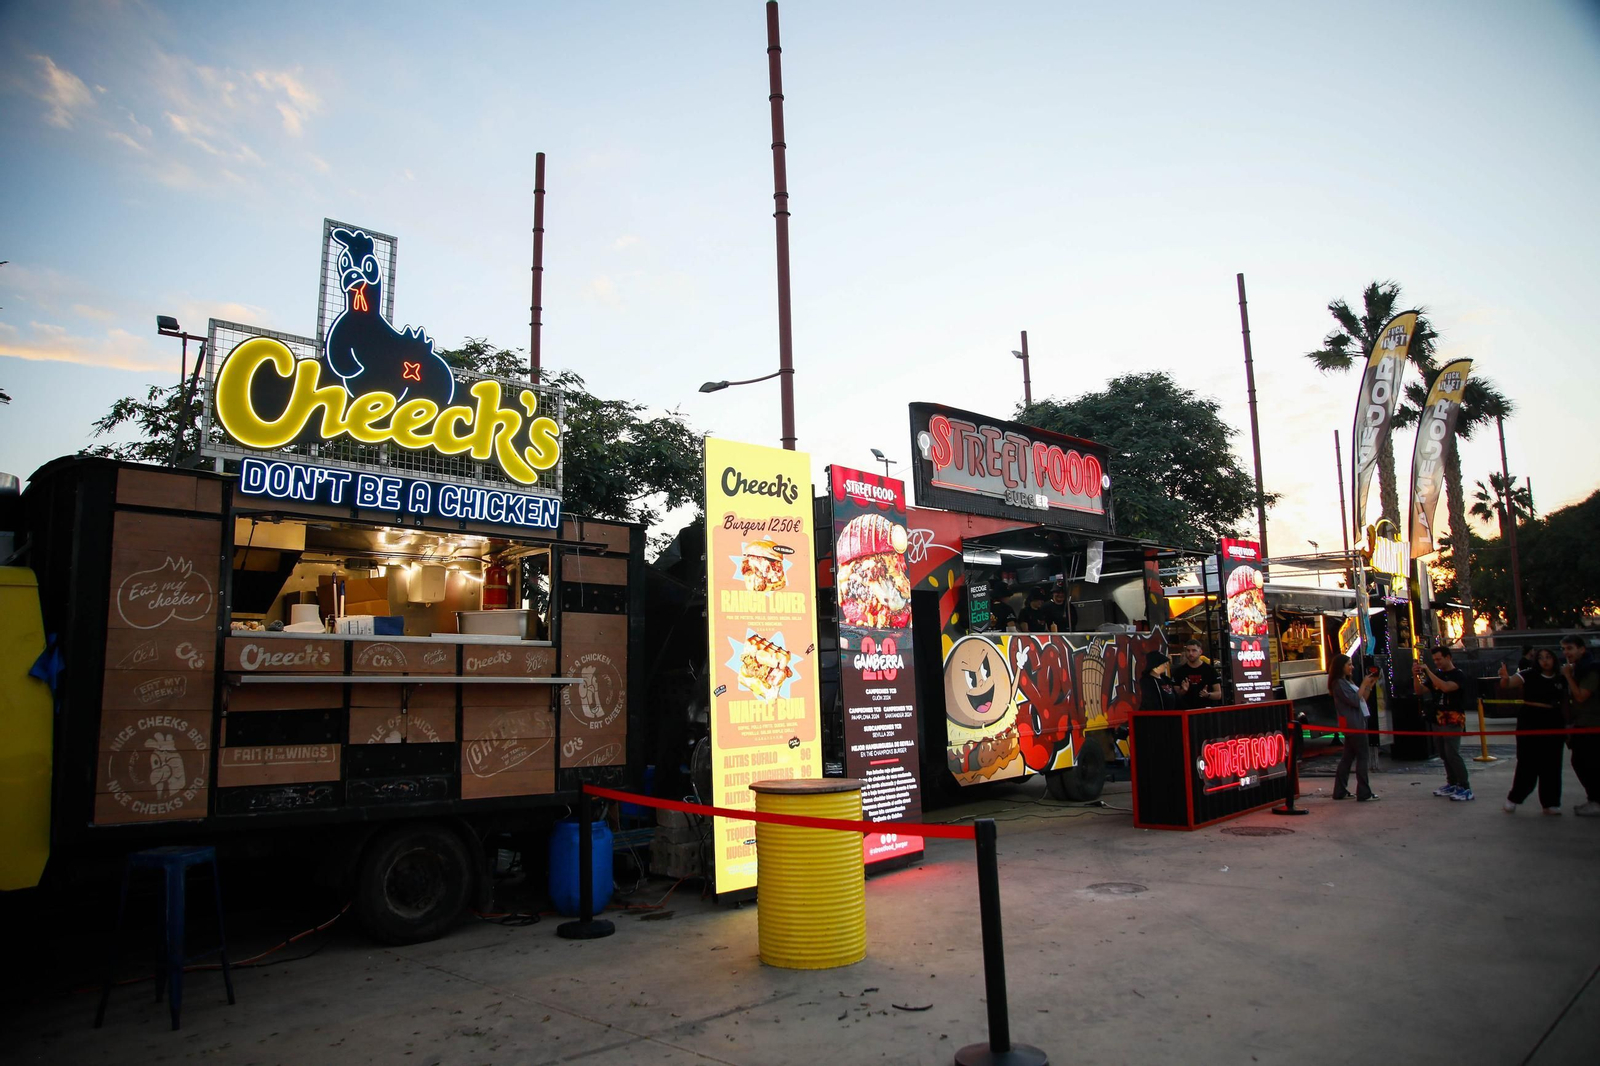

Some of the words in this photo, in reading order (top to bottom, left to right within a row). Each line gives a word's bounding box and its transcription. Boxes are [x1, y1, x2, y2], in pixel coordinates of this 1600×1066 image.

[1387, 325, 1404, 336] FUCK
[215, 336, 561, 485] Cheeck's
[930, 415, 1030, 489] STREET
[1032, 441, 1102, 498] FOOD
[1417, 400, 1451, 507] MEJOR
[240, 458, 352, 504] DON'T
[356, 474, 403, 511] BE
[408, 480, 432, 514] A
[438, 485, 561, 529] CHICKEN
[721, 466, 799, 505] Cheeck's
[845, 479, 872, 498] STREET
[872, 485, 894, 502] FOOD
[1005, 490, 1049, 510] BURGER
[723, 514, 766, 537] Burgers
[767, 517, 801, 534] 12,50€
[129, 581, 158, 601] Eat
[161, 579, 188, 594] my
[970, 584, 987, 593] RECOGE
[720, 590, 767, 613] RANCH
[769, 591, 806, 614] LOVER
[971, 600, 989, 611] Uber
[971, 611, 990, 623] Eats
[240, 643, 331, 671] Cheeck's
[466, 649, 512, 672] Cheeck's
[580, 652, 612, 666] CHICKEN
[853, 652, 905, 672] GAMBERRA
[164, 676, 182, 687] MY
[728, 699, 775, 724] WAFFLE
[109, 725, 137, 752] NICE
[137, 715, 188, 731] CHEEKS
[187, 727, 207, 750] BRO
[589, 720, 604, 730] EAT
[234, 747, 274, 761] FAITH
[286, 745, 329, 760] WINGS
[723, 753, 750, 769] ALITAS
[750, 750, 779, 767] BÚFALO
[1203, 738, 1250, 779] STREET
[1251, 733, 1286, 770] FOOD
[724, 771, 751, 787] ALITAS
[106, 779, 132, 807] NICE
[131, 797, 184, 815] CHEEKS
[183, 777, 205, 801] BRO
[725, 790, 751, 806] ALITAS
